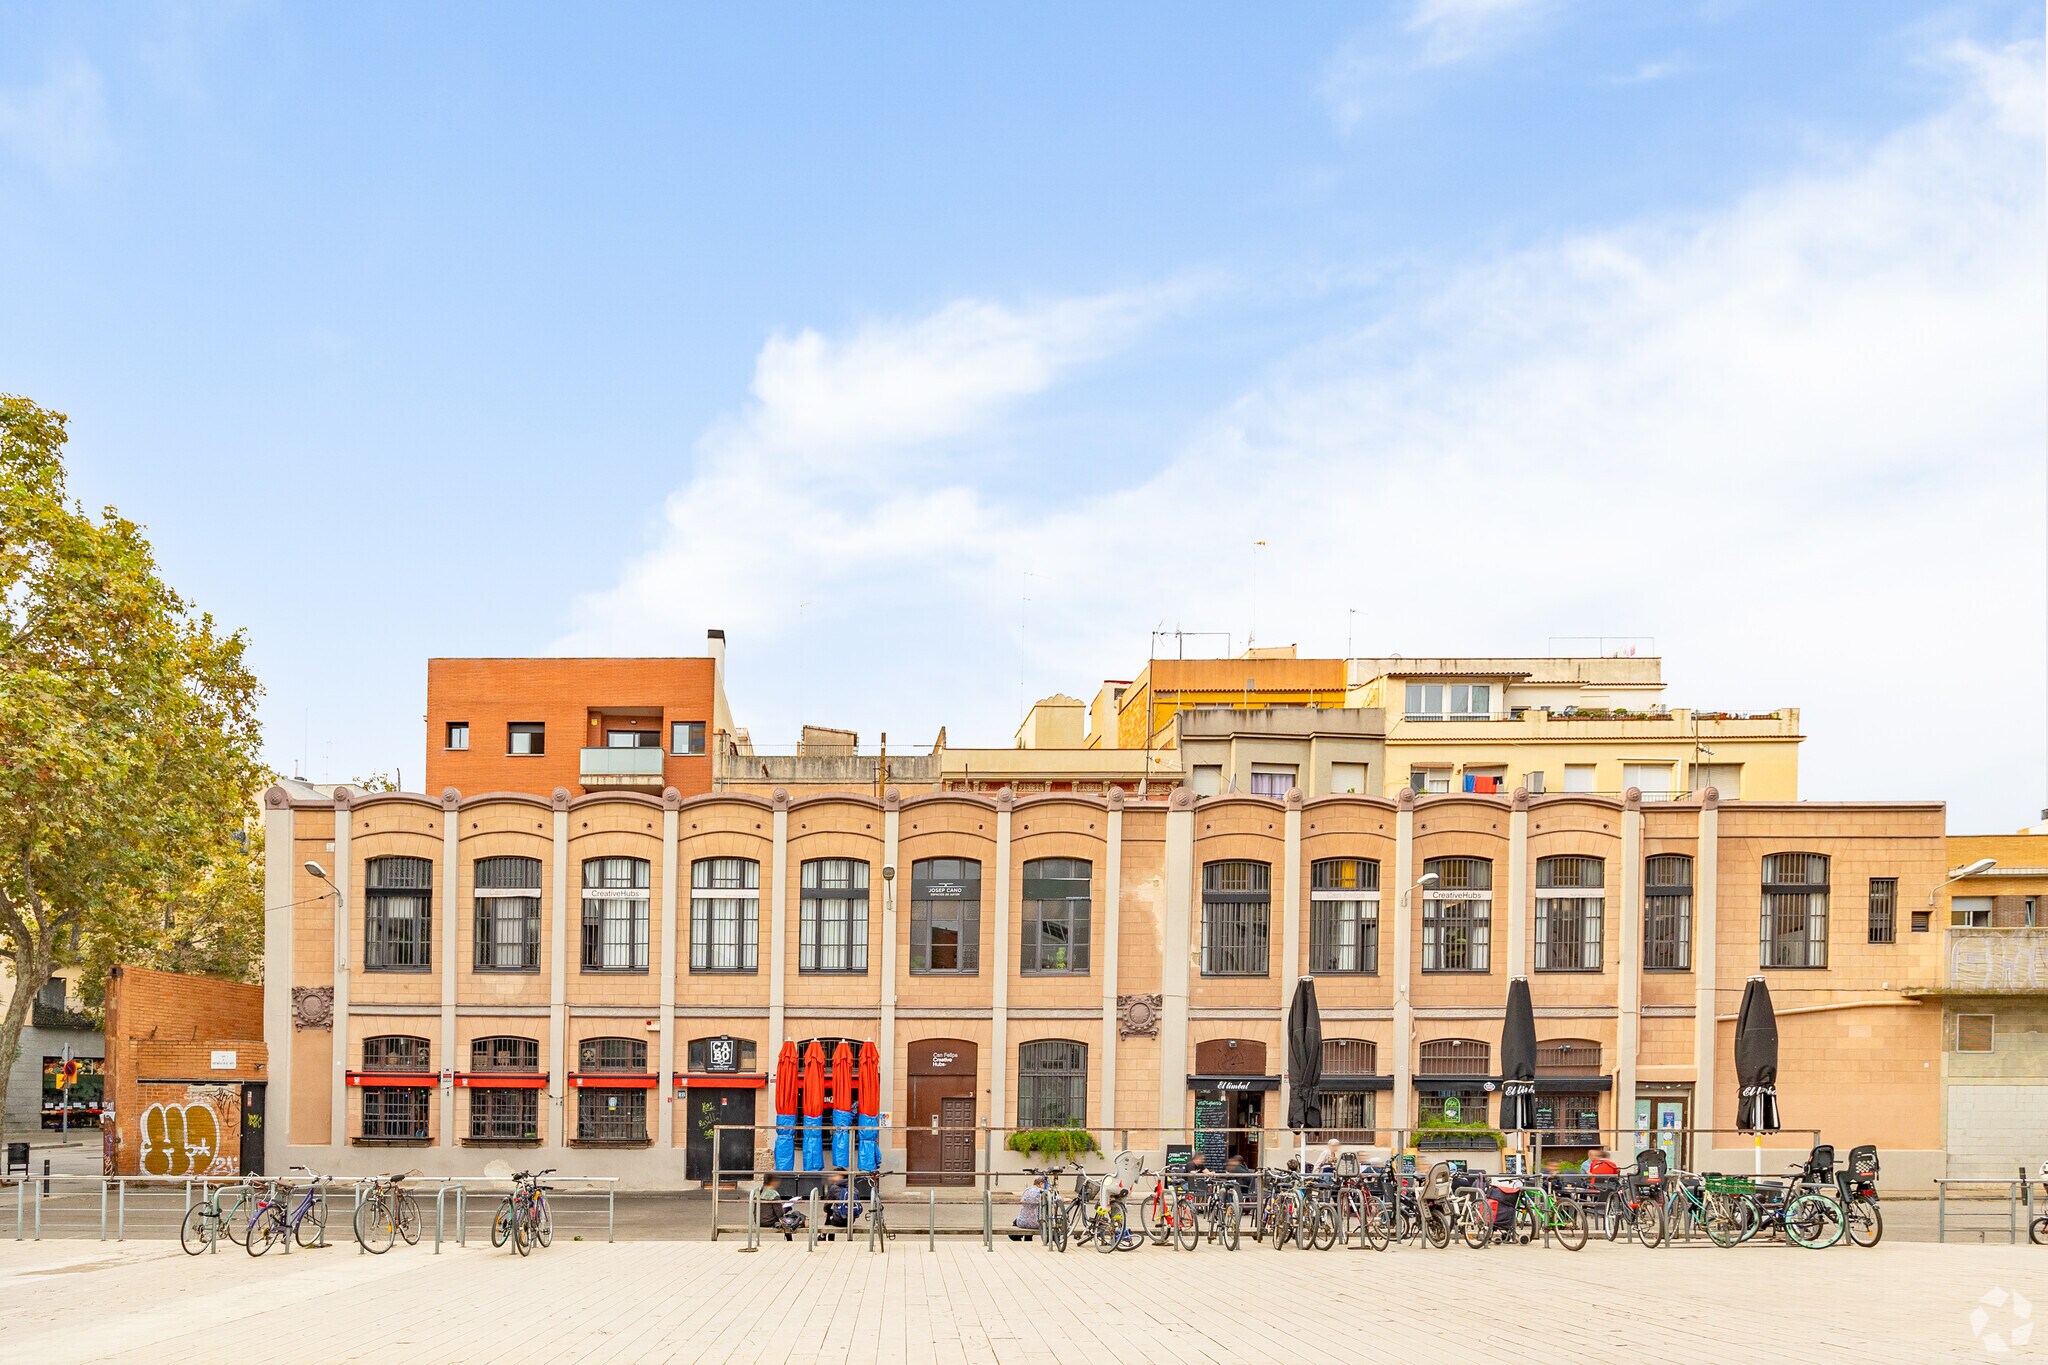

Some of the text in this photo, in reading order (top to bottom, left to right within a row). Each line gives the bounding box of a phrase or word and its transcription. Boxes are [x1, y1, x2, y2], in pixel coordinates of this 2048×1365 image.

[591, 889, 640, 897] CreativeHubs
[1432, 891, 1482, 899] CreativeHubs
[712, 1042, 730, 1052] CA
[713, 1051, 730, 1061] BO
[1217, 1081, 1226, 1090] El
